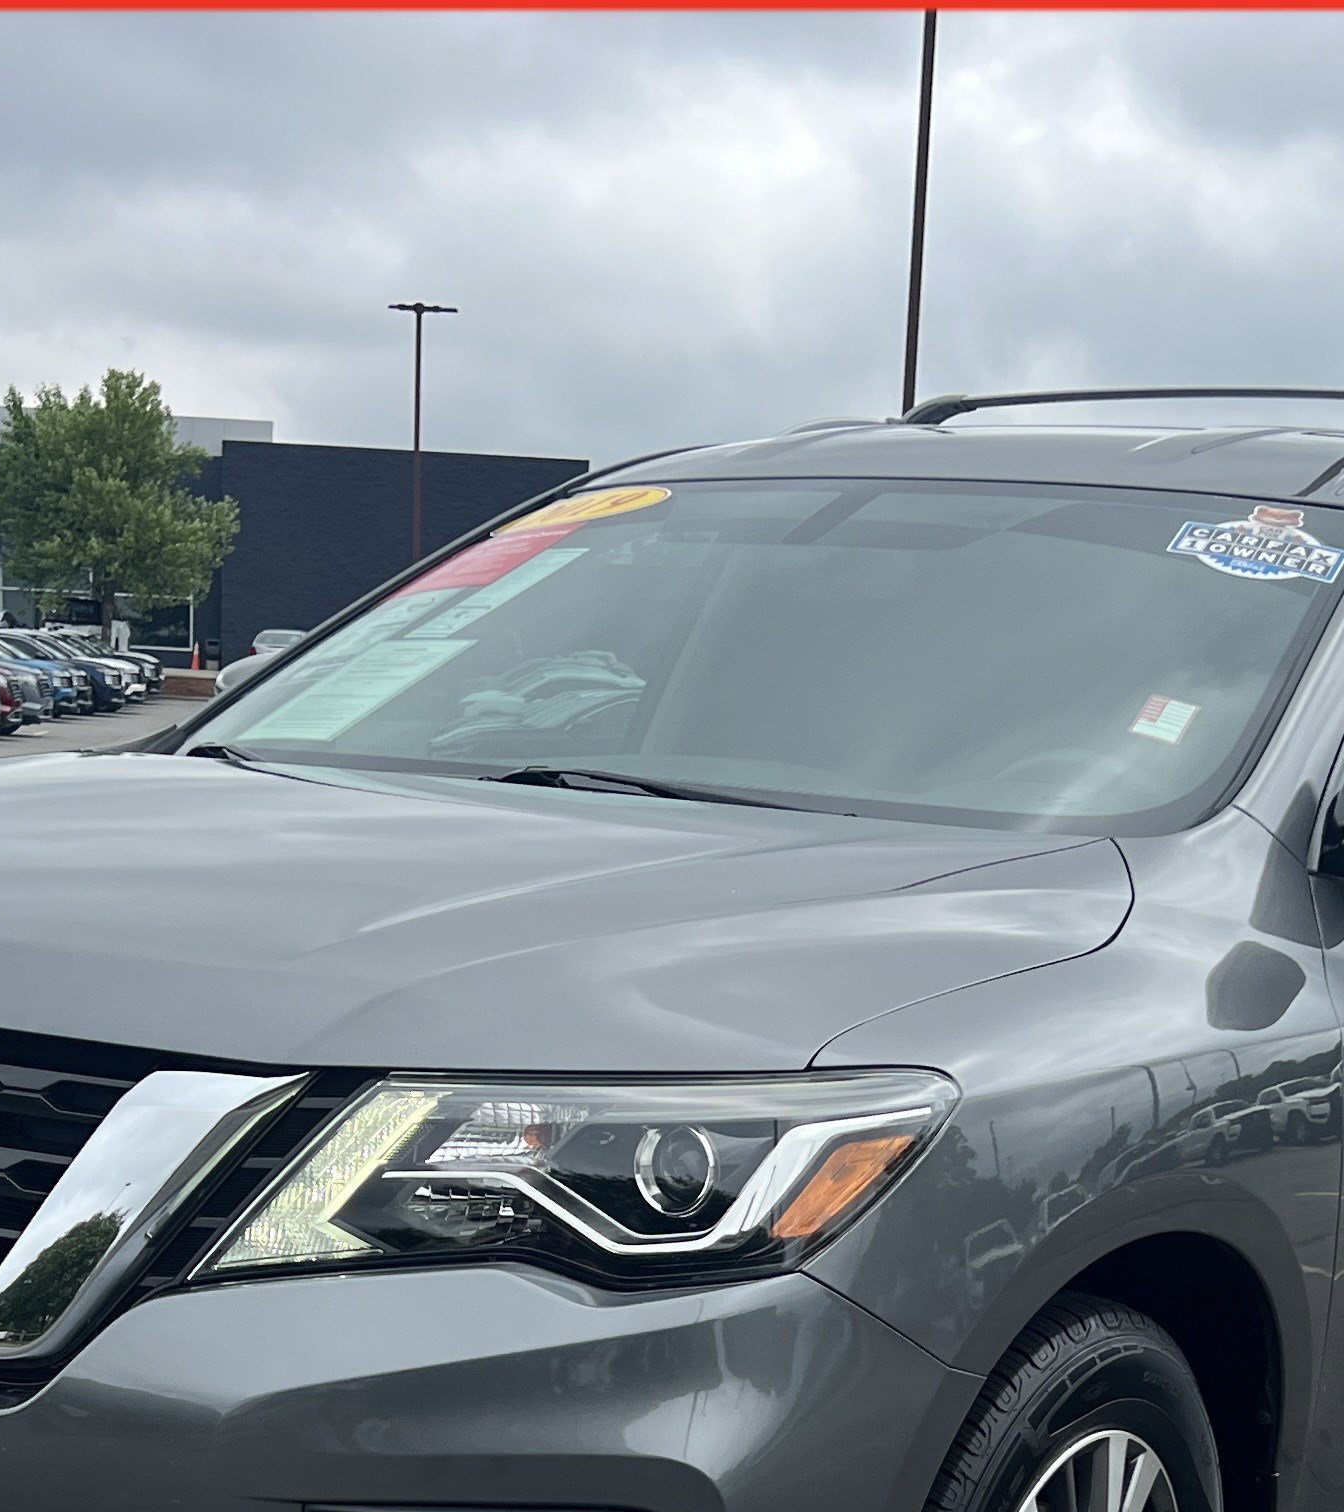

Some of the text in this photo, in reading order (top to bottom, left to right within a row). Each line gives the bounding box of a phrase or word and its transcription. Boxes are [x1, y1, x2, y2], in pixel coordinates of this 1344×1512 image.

[1184, 539, 1199, 551] 1
[1208, 541, 1327, 575] OWNER
[1192, 526, 1336, 564] CARFAX
